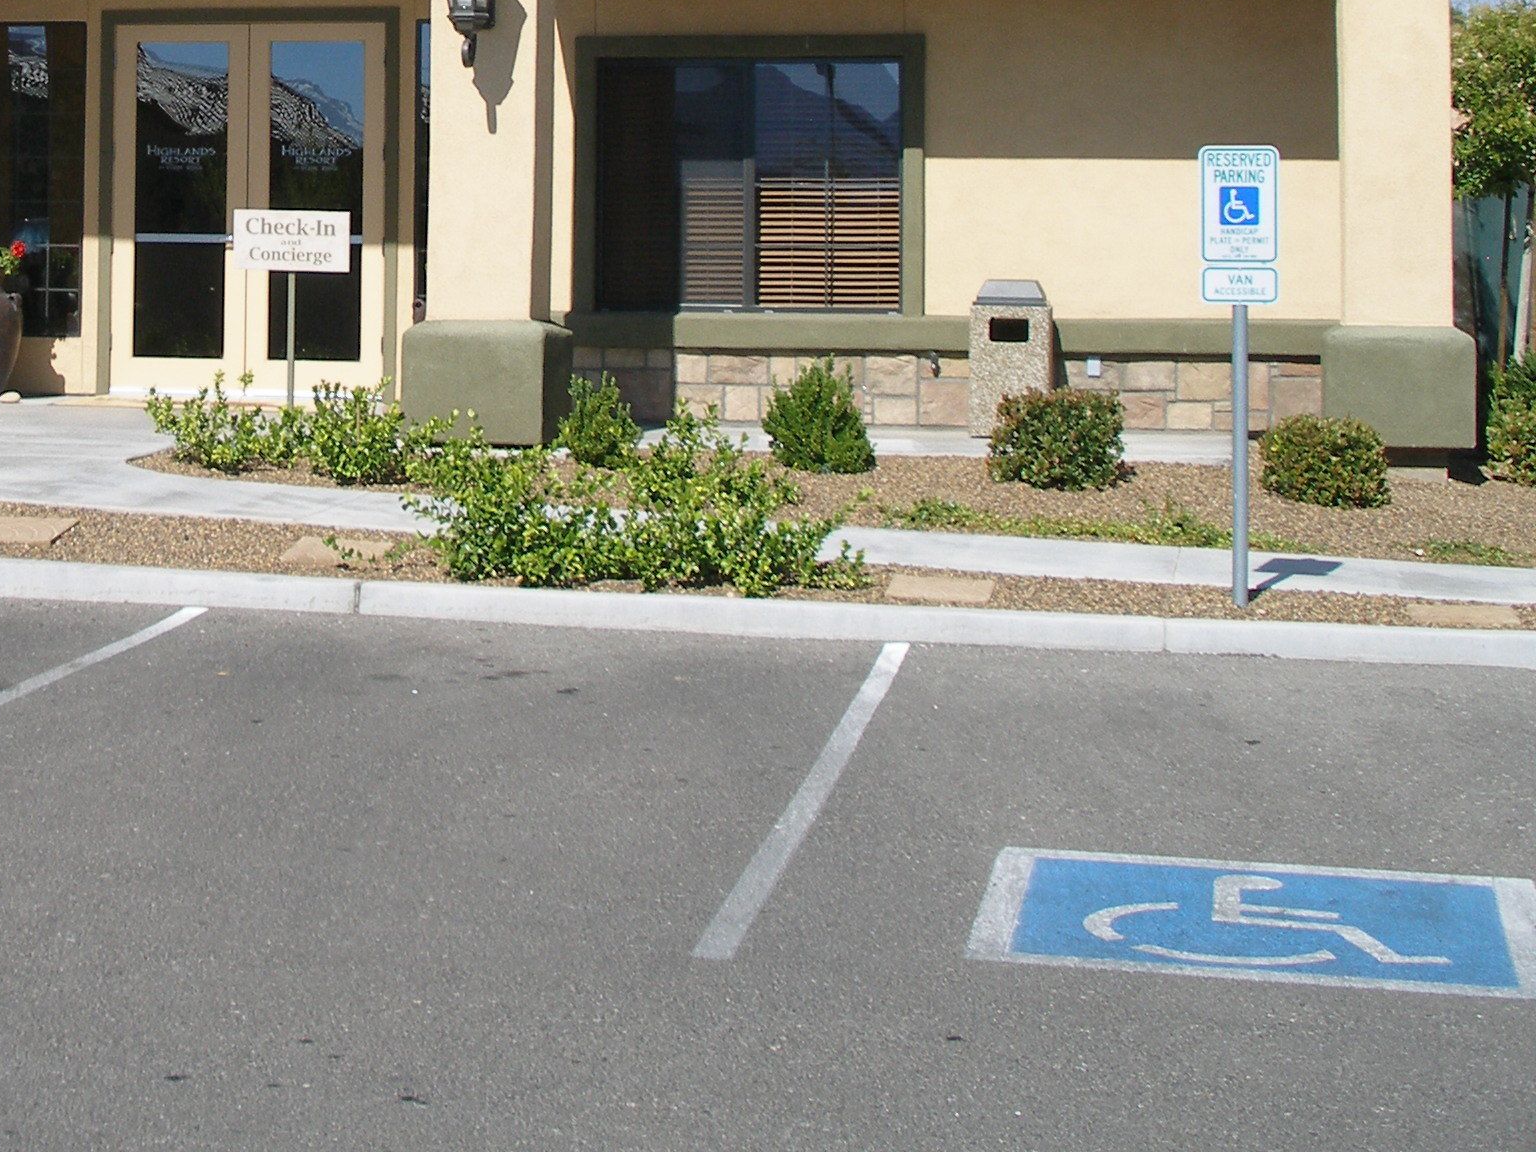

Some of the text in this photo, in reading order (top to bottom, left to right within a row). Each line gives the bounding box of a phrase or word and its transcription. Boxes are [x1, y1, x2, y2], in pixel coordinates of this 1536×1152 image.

[1207, 153, 1271, 167] RESERVED
[1213, 170, 1265, 183] PARKING
[246, 218, 336, 236] Check-In
[249, 247, 332, 265] Concierge
[1228, 274, 1253, 285] VAN
[1214, 287, 1266, 295] ACCESSIBLE
